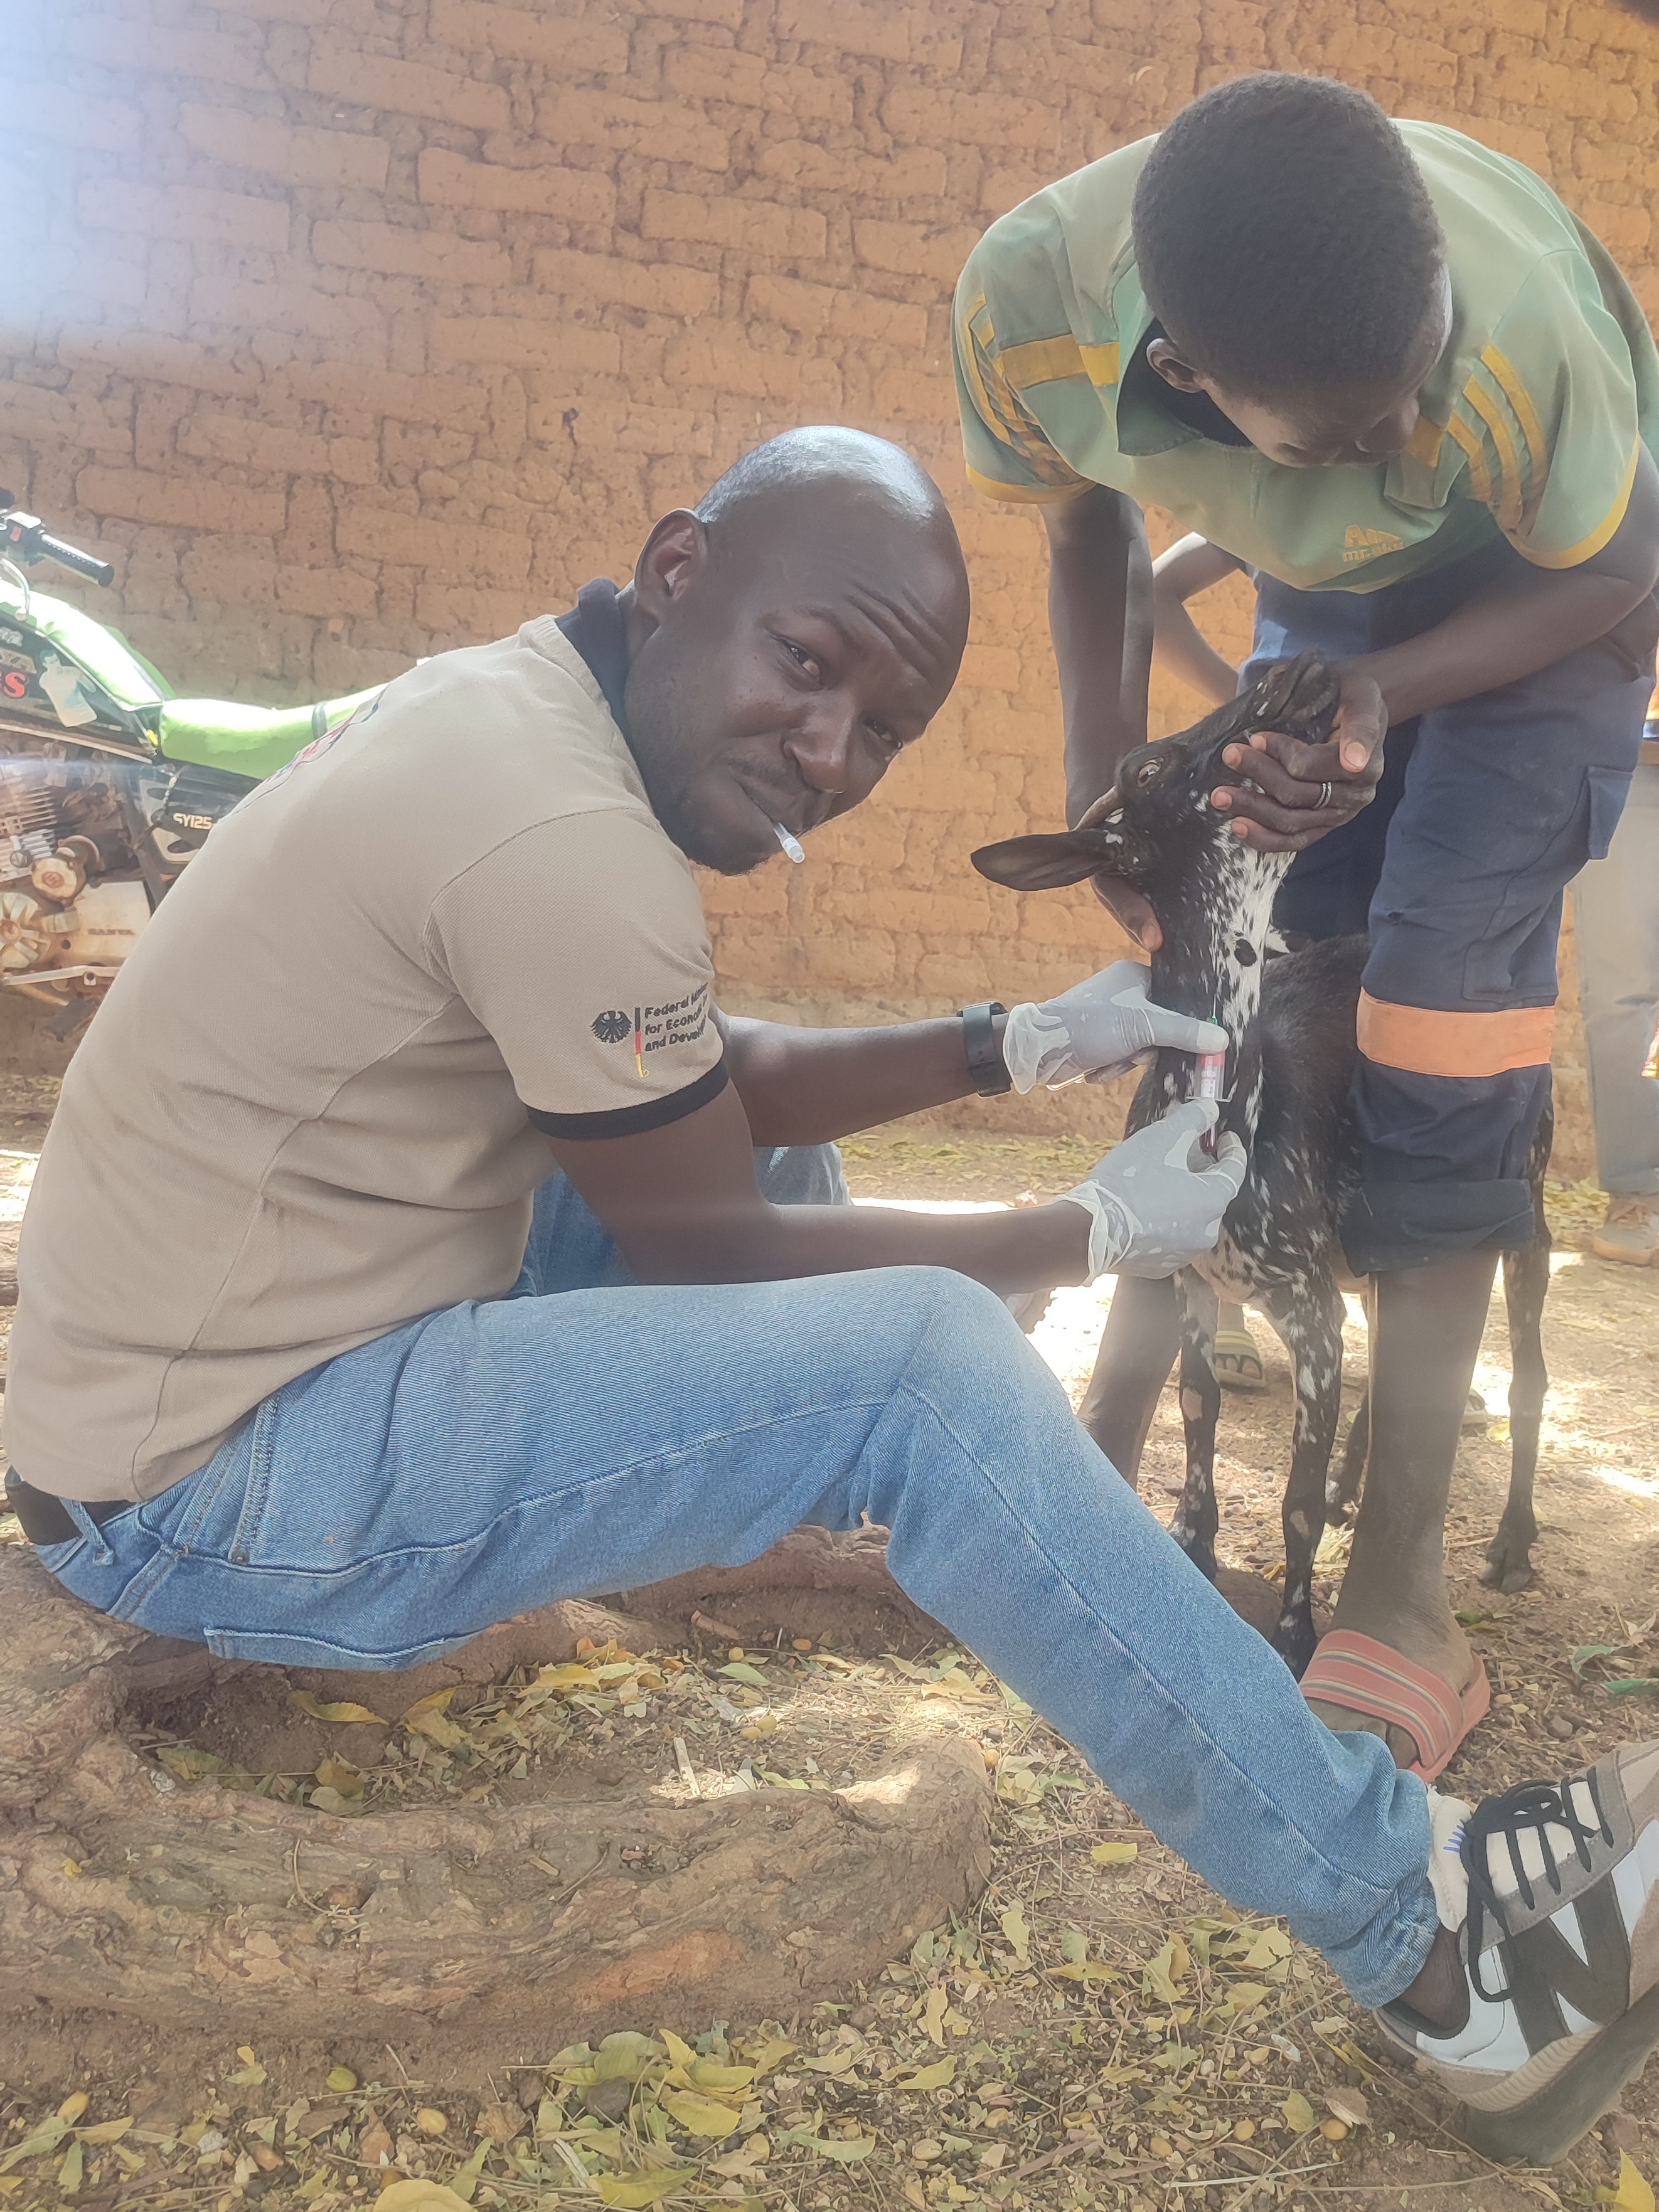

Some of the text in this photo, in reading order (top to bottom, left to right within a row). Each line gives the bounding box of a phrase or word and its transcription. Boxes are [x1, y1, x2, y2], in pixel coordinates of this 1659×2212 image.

[0, 671, 27, 698] S
[644, 995, 690, 1019] Federal
[645, 1024, 663, 1035] for
[644, 1035, 666, 1052] and
